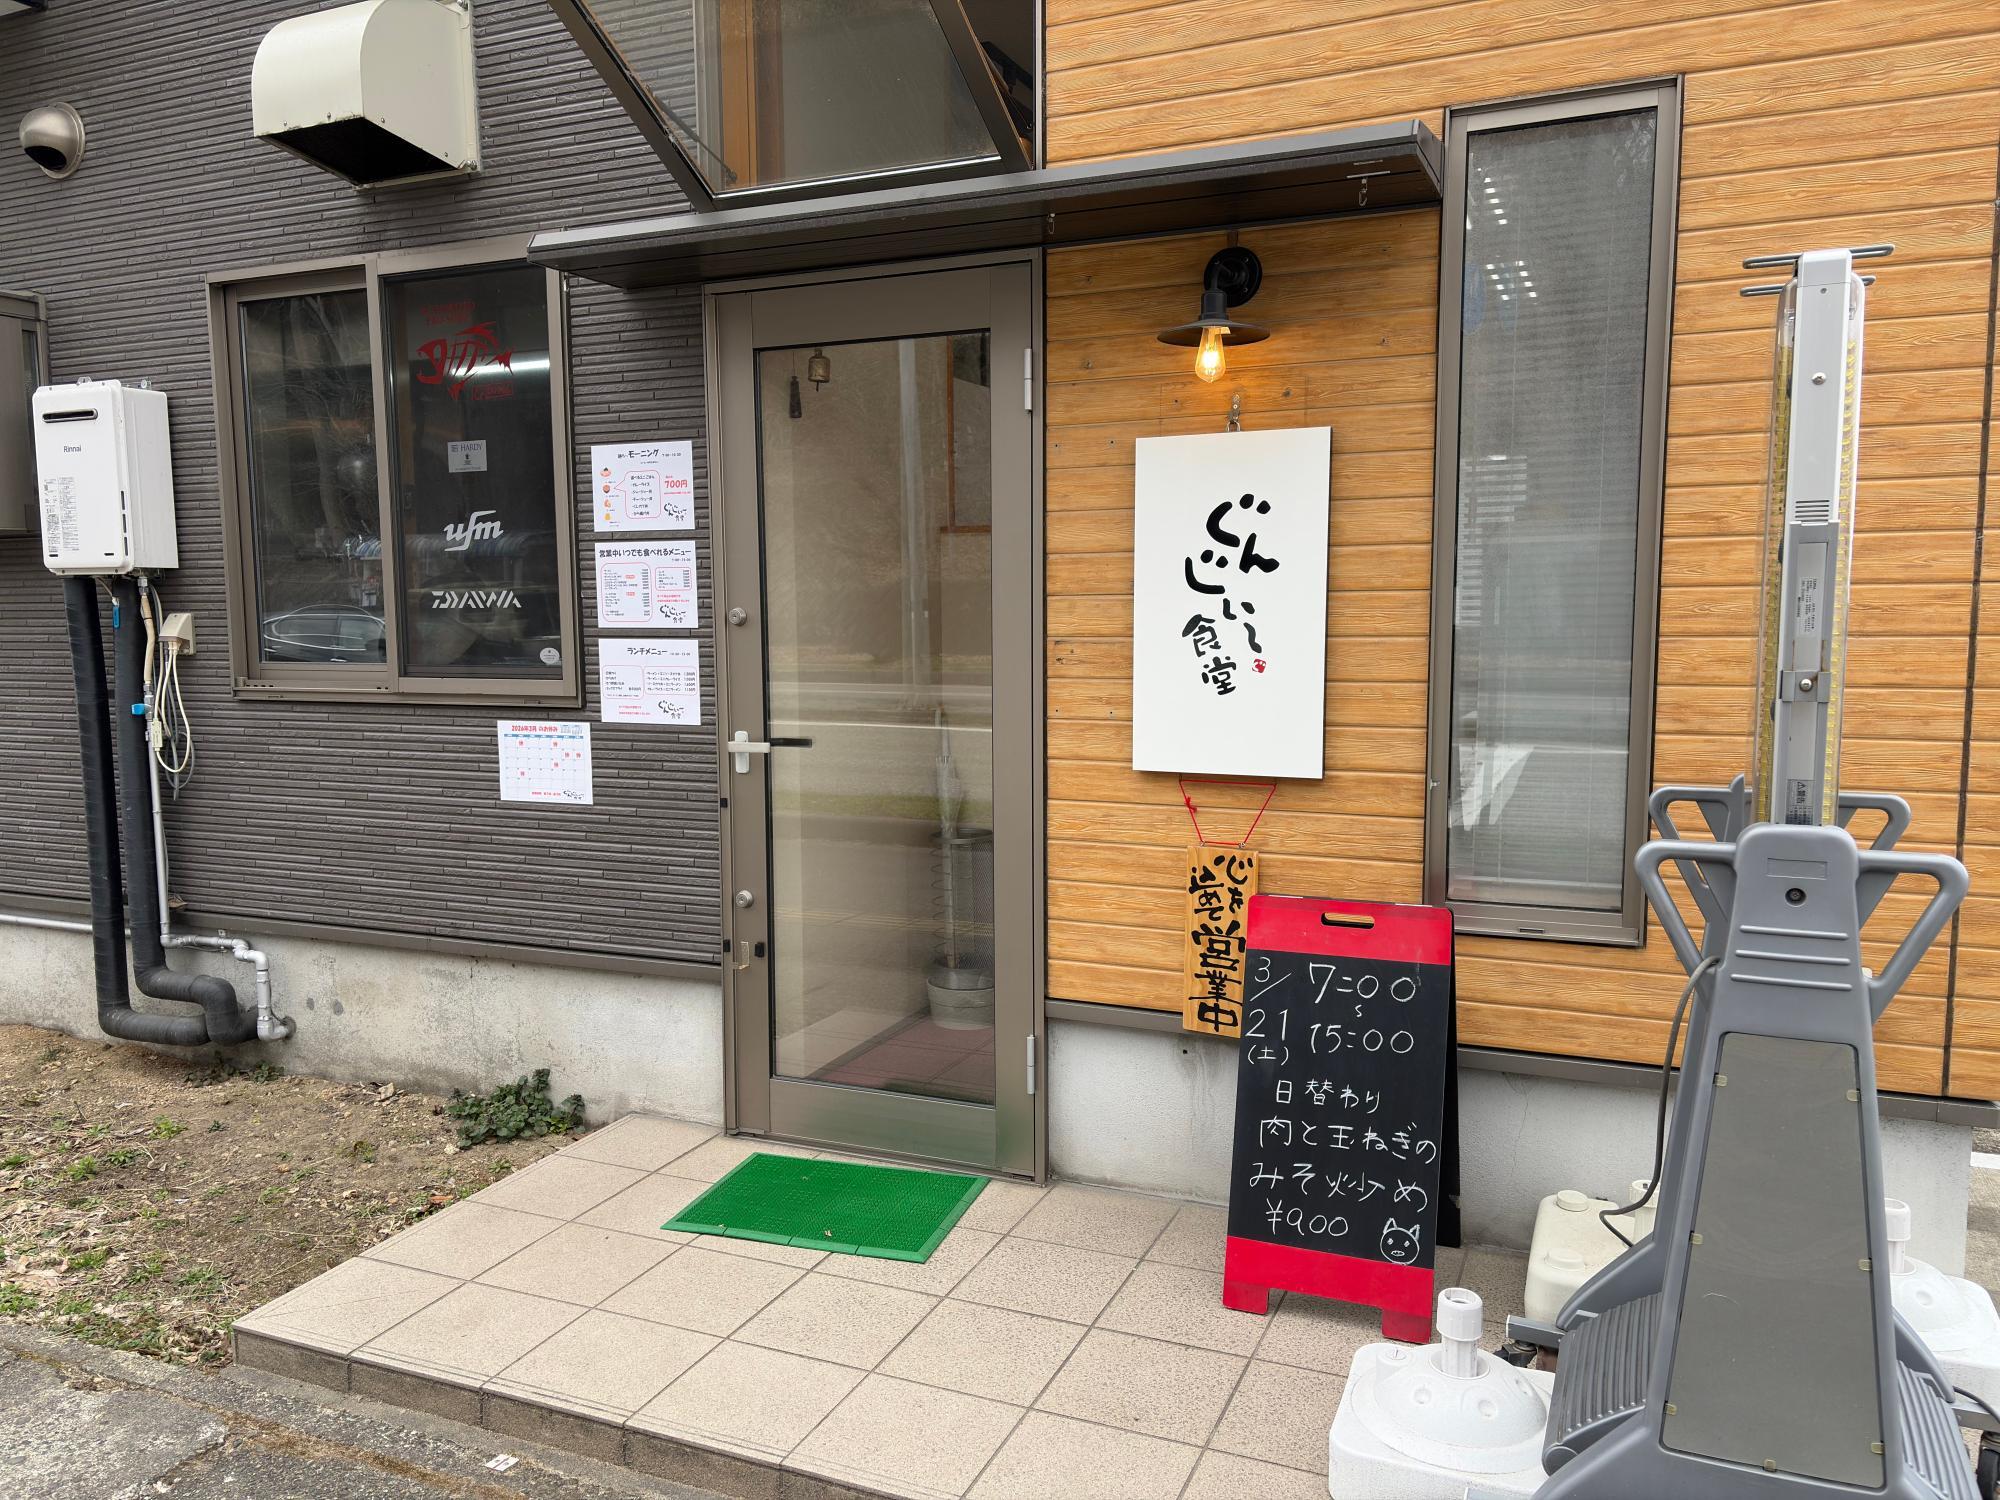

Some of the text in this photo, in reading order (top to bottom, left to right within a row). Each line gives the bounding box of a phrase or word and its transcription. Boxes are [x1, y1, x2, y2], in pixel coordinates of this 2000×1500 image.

[63, 445, 82, 453] Rinnai
[628, 449, 659, 458] モーニング
[664, 480, 688, 488] 700円
[443, 510, 504, 552] ufm
[599, 549, 691, 558] 営業中いつでも食べれるメニュー
[627, 647, 668, 655] ランチメニュー
[1182, 614, 1236, 695] 食堂
[1188, 919, 1247, 1032] 営業中
[1276, 1079, 1381, 1114] 日替わり
[1259, 1115, 1437, 1164] 肉と玉ねぎの
[1249, 1162, 1428, 1213] みそ炒め
[1266, 1198, 1349, 1237] ¥900
